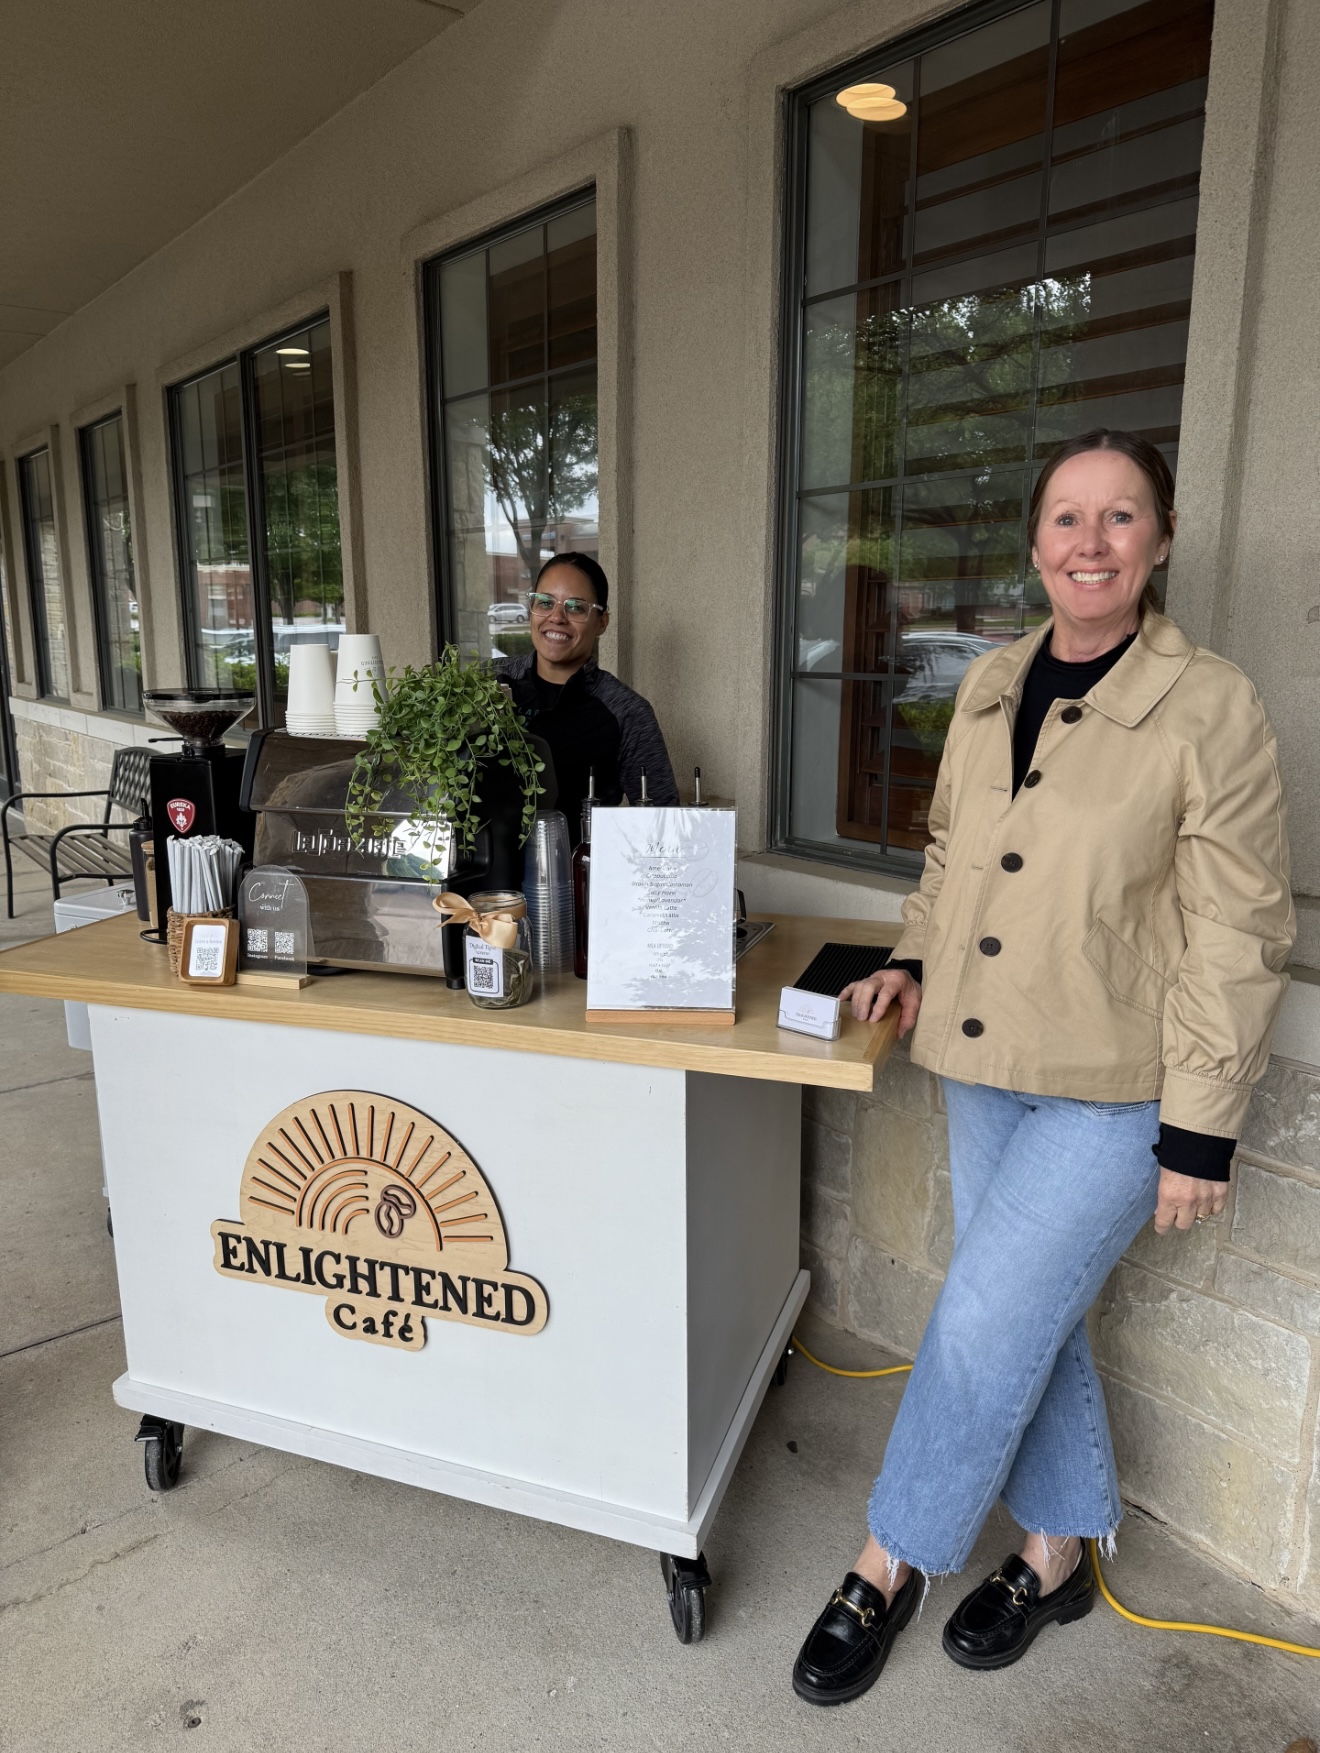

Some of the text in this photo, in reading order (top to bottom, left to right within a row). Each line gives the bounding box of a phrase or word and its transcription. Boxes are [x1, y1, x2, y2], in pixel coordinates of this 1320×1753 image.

[248, 879, 295, 909] Connect
[259, 902, 272, 911] with
[217, 1231, 536, 1327] ENLIGHTENED
[333, 1303, 416, 1343] Café
